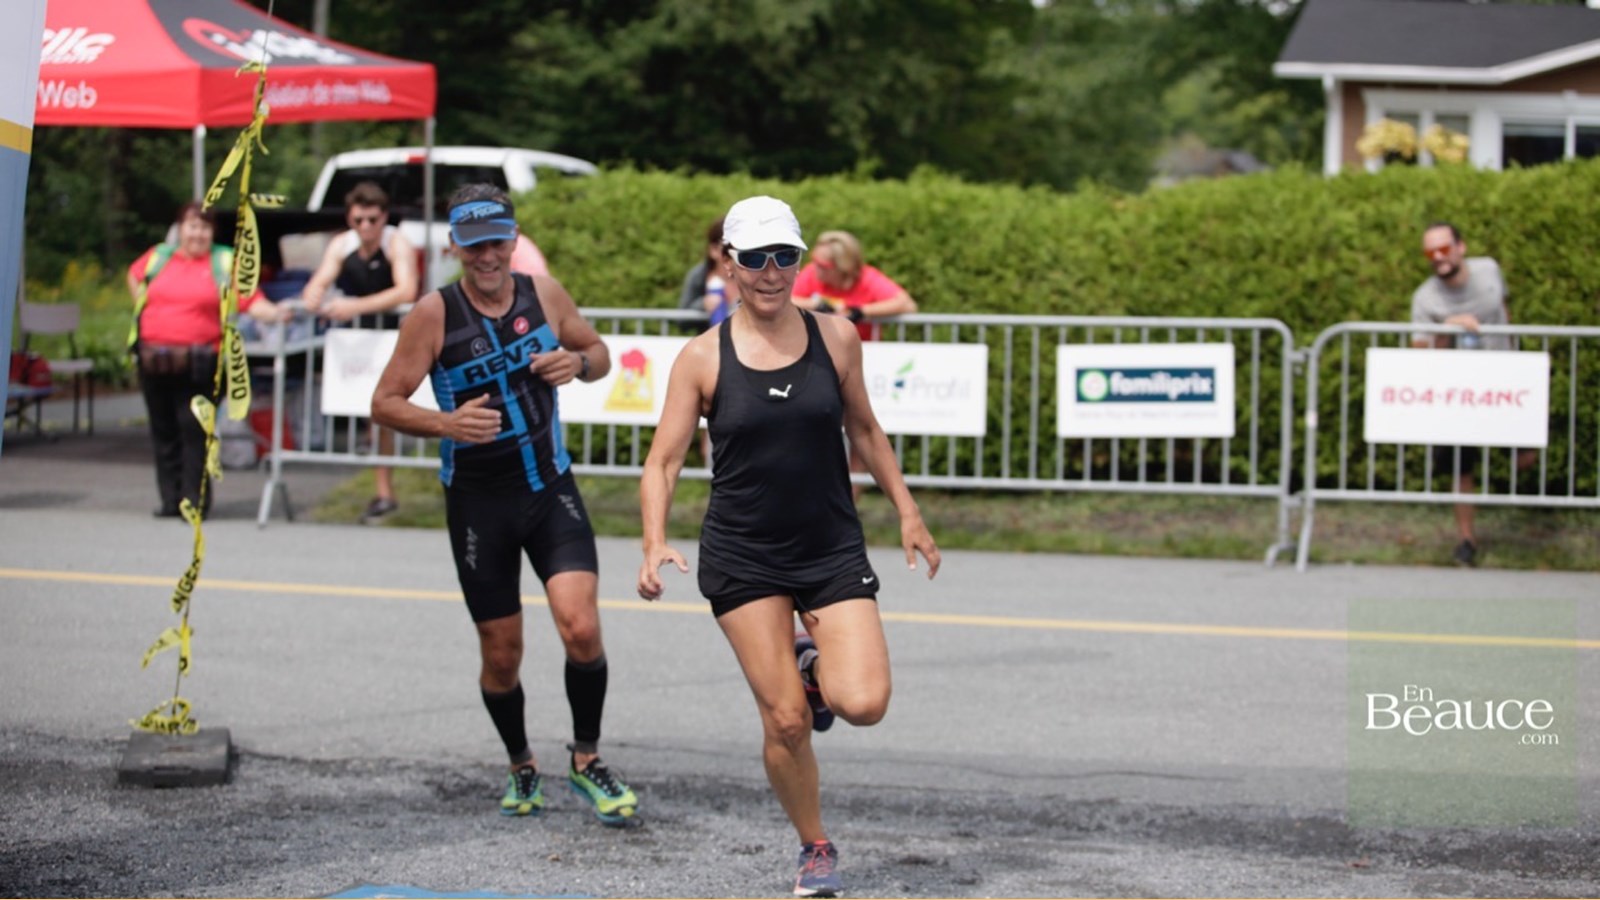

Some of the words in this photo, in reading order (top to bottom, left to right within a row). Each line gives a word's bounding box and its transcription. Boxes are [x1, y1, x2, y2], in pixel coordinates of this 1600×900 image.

[38, 80, 98, 109] Web
[463, 337, 542, 384] REV3
[1110, 371, 1213, 400] familiprix
